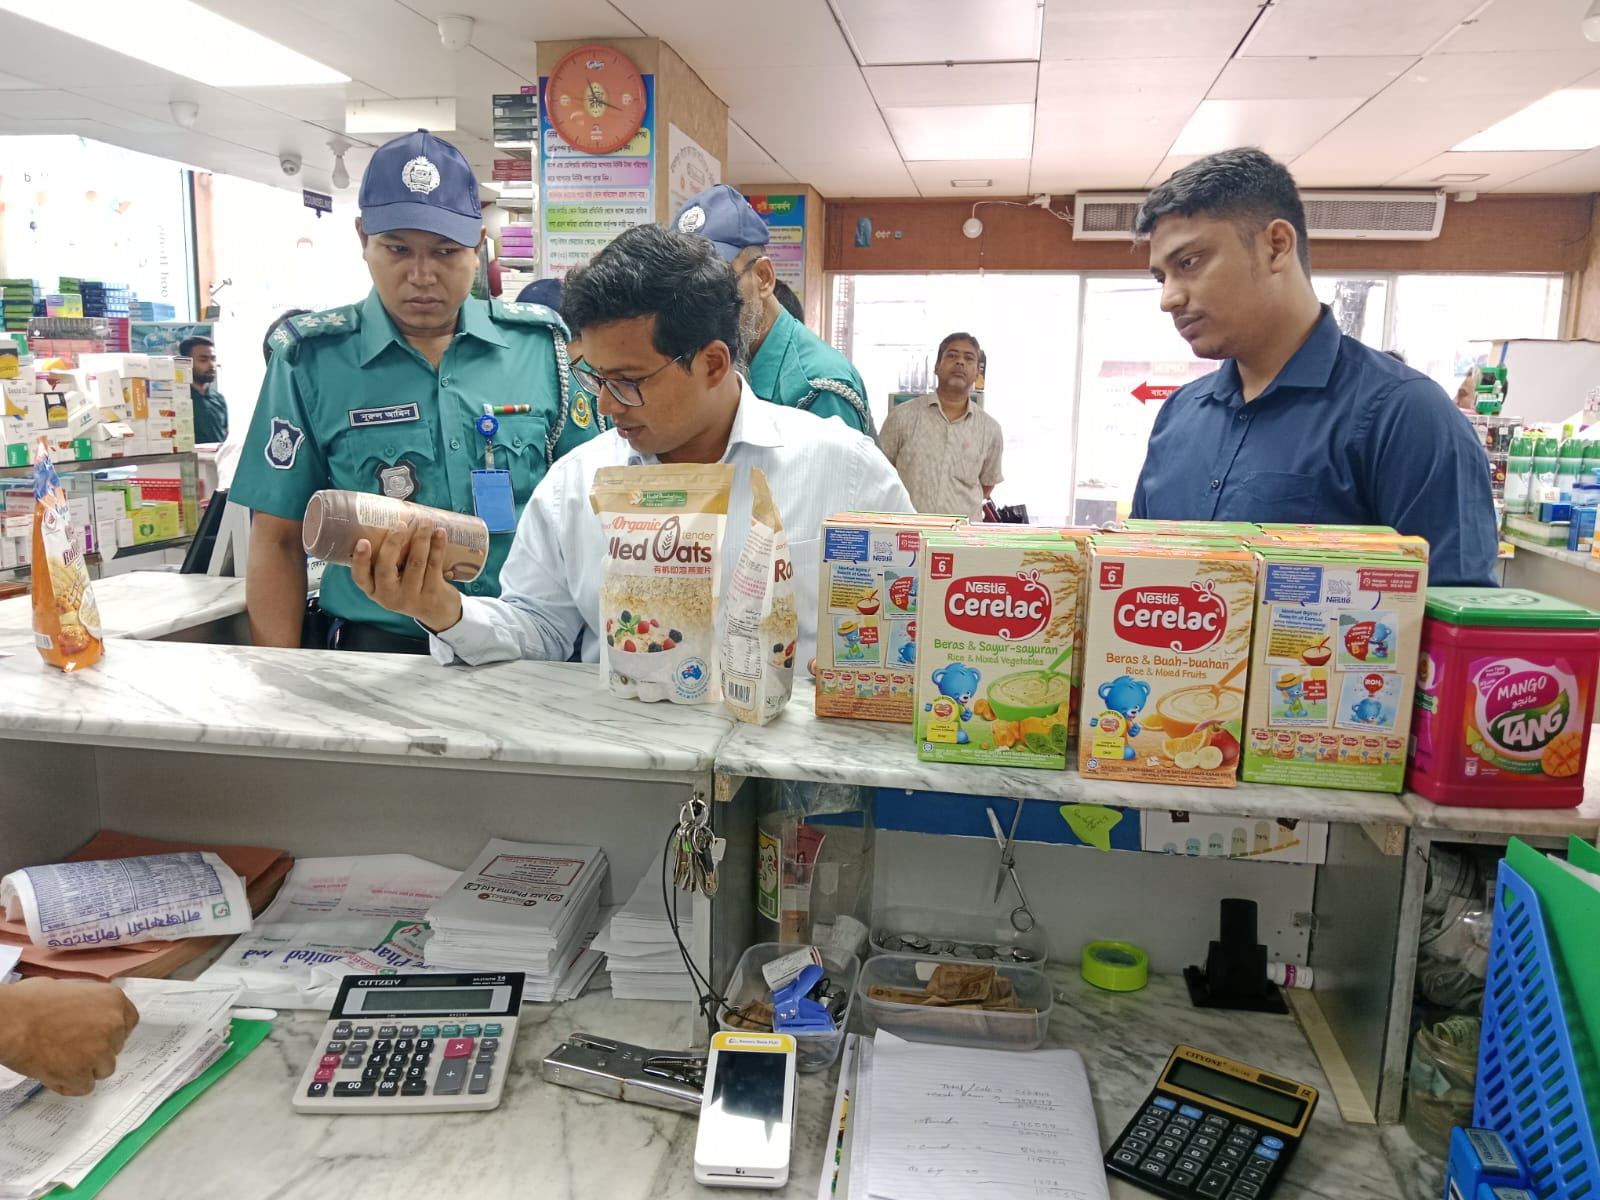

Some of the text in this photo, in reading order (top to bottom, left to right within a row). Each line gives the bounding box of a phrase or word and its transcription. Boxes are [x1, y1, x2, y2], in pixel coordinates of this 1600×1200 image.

[613, 516, 661, 534] Organic
[608, 537, 648, 561] lled
[774, 558, 793, 583] Ro
[939, 561, 946, 572] 6
[1107, 570, 1117, 582] 6
[949, 593, 1043, 620] Cerelac
[1118, 604, 1218, 631] Cerelac
[934, 638, 1058, 657] Beras & Sayur-sayuran
[947, 653, 965, 662] Rice
[976, 655, 999, 664] Mixed
[1001, 656, 1044, 667] Vegetables
[1106, 652, 1229, 670] Beras & Buah-buahan
[1126, 666, 1144, 676] Rice
[1155, 668, 1180, 678] Mixed
[1182, 669, 1207, 679] Fruits
[1497, 675, 1548, 701] MANGO
[1497, 704, 1563, 747] TANG
[1185, 1050, 1222, 1067] CITYONE
